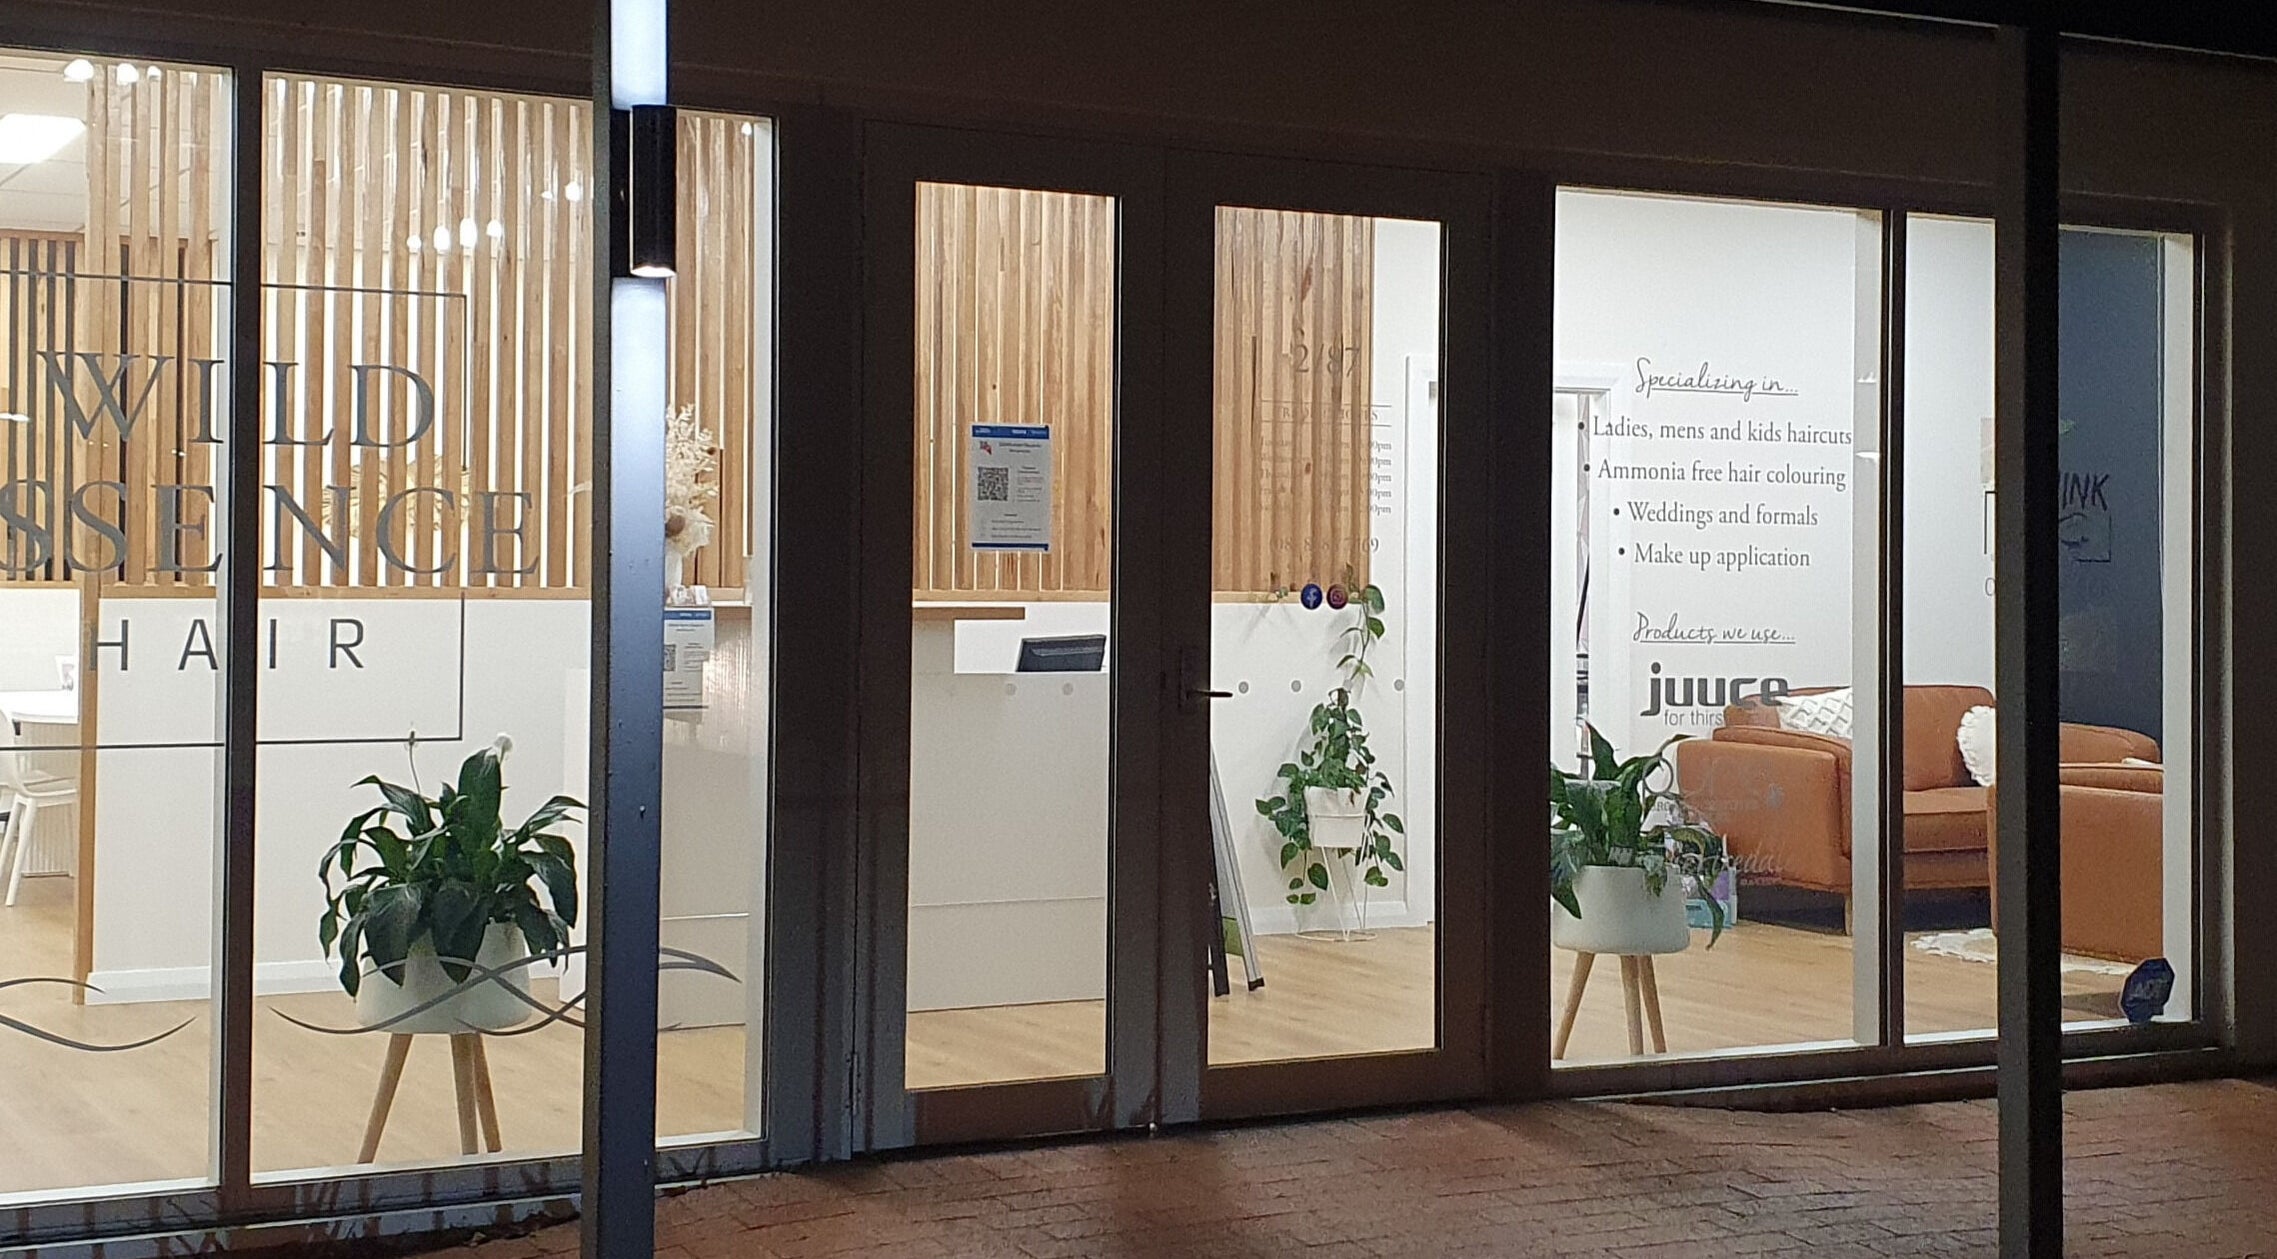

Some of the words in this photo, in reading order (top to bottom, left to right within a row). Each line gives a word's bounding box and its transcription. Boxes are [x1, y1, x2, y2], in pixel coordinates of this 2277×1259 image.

[1635, 357, 1757, 402] Specializing
[36, 350, 436, 448] WILD
[1593, 415, 1654, 439] Ladies,
[1660, 423, 1705, 440] mens
[1710, 420, 1742, 441] and
[1748, 420, 1782, 443] kids
[1787, 421, 1852, 445] haircuts
[1598, 459, 1686, 481] Ammonia
[1692, 460, 1723, 482] free
[1729, 461, 1763, 483] hair
[1766, 462, 1847, 492] colouring
[2060, 472, 2111, 511] INK
[0, 479, 540, 576] SSENCE
[1627, 501, 1714, 530] Weddings
[1718, 503, 1750, 524] and
[1756, 504, 1819, 525] formals
[1634, 542, 1684, 565] Make
[1688, 550, 1711, 571] up
[1716, 544, 1811, 571] application
[88, 618, 366, 671] HAIR
[1633, 611, 1717, 644] Products
[1721, 628, 1747, 640] we
[1640, 662, 1790, 716] juuce
[1664, 709, 1685, 726] for
[1690, 709, 1725, 727] thirs
